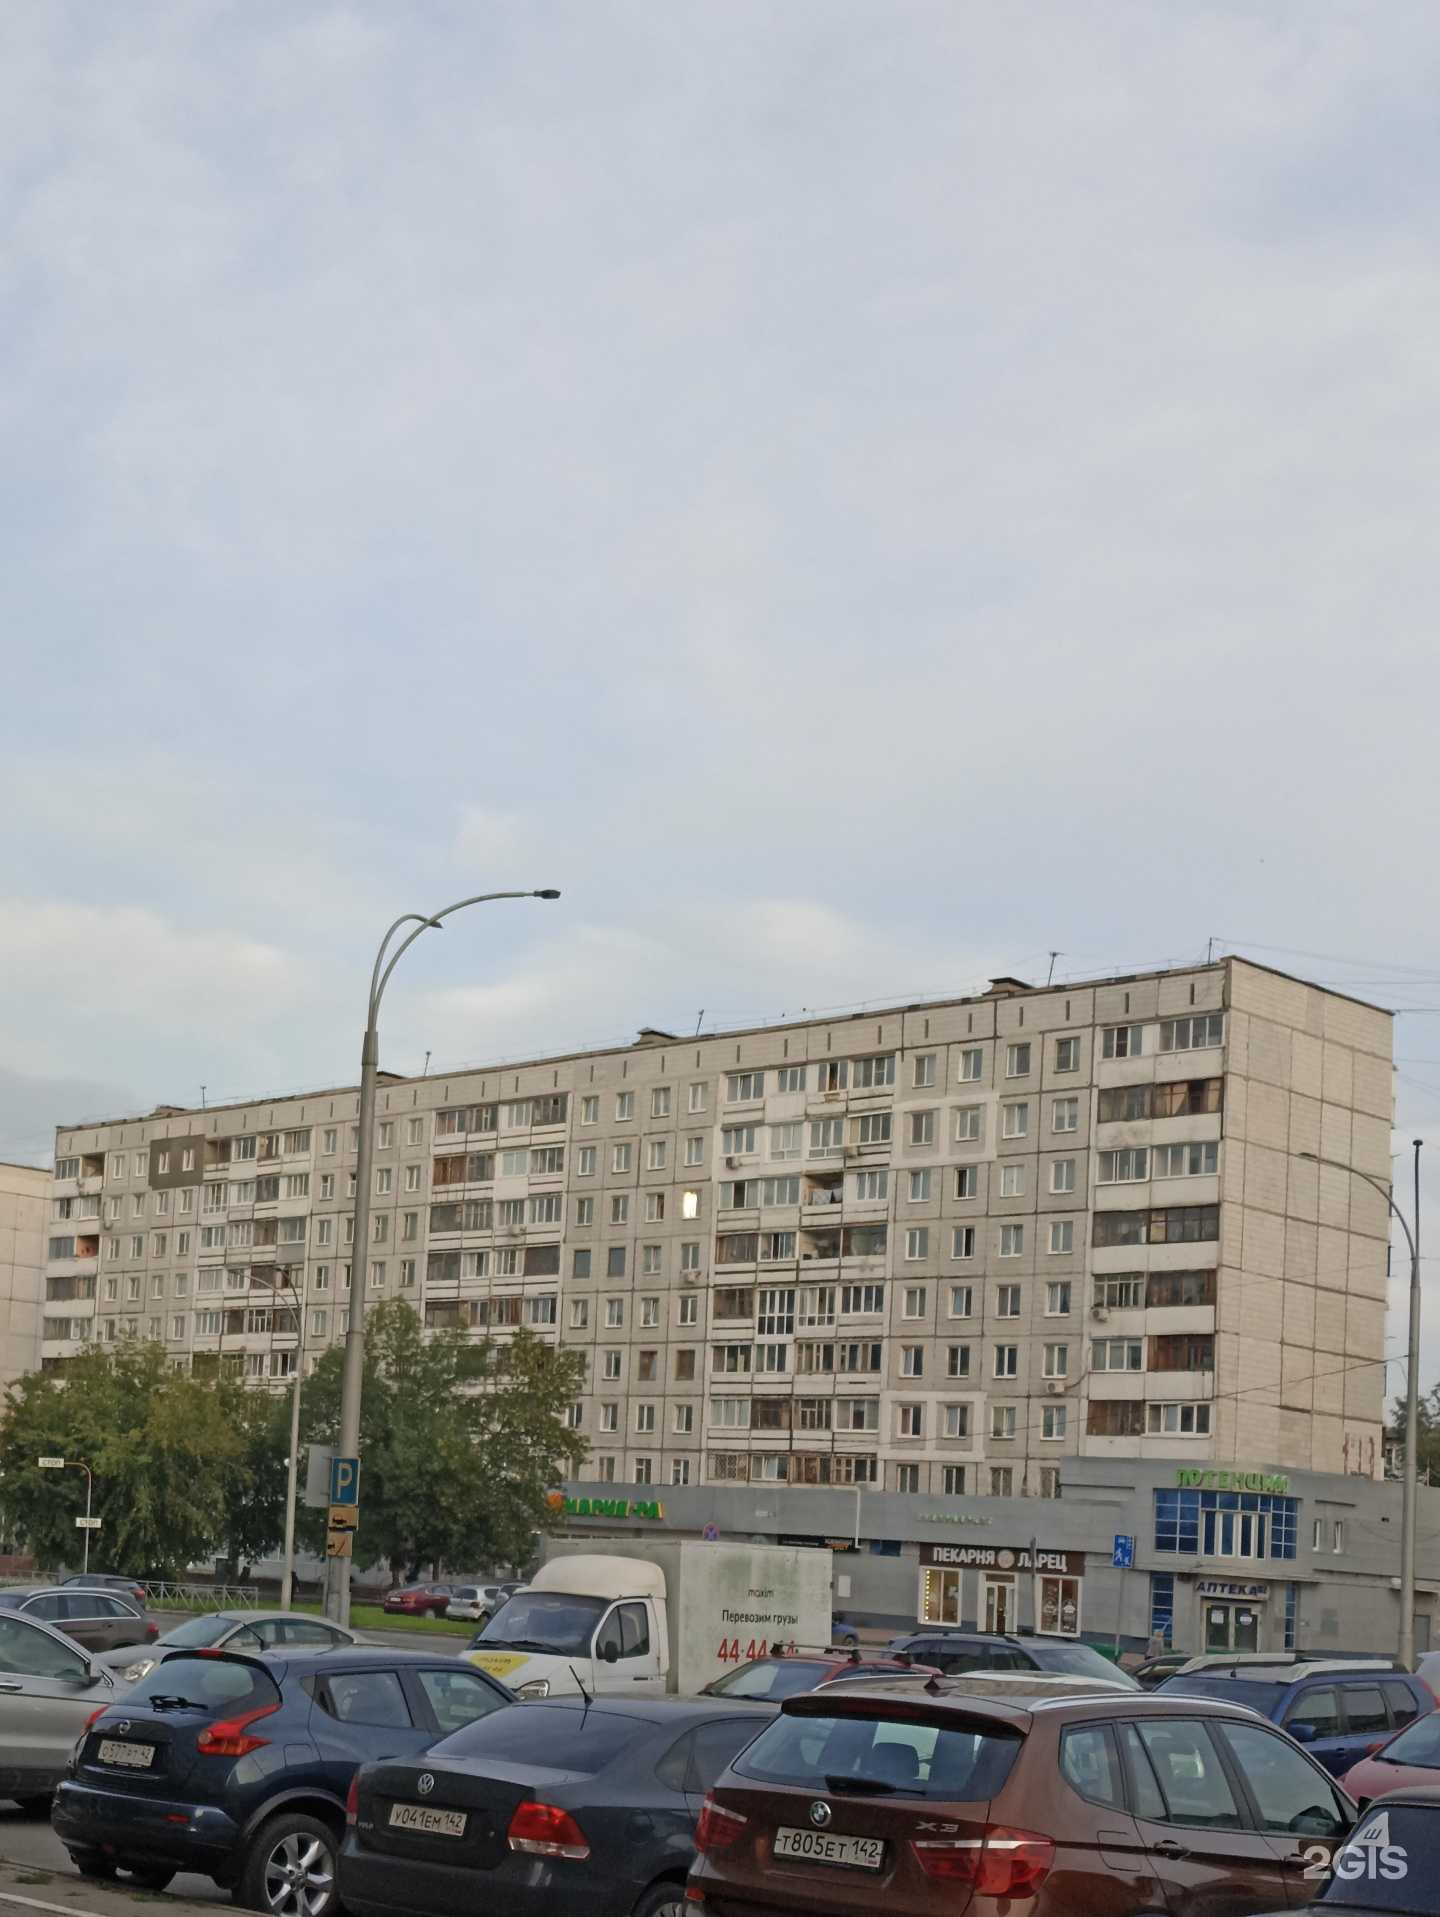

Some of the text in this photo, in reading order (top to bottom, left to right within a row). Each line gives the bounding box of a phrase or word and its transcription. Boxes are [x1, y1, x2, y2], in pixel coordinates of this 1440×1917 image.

[336, 1463, 352, 1499] P
[933, 1546, 996, 1565] ПЕКАРНЯ
[748, 1588, 774, 1598] maxim
[1196, 1582, 1258, 1596] АПТЕКА
[722, 1609, 799, 1625] Перевозим грузы
[443, 1813, 463, 1829] 142
[782, 1832, 879, 1859] Т805ЕТ 142
